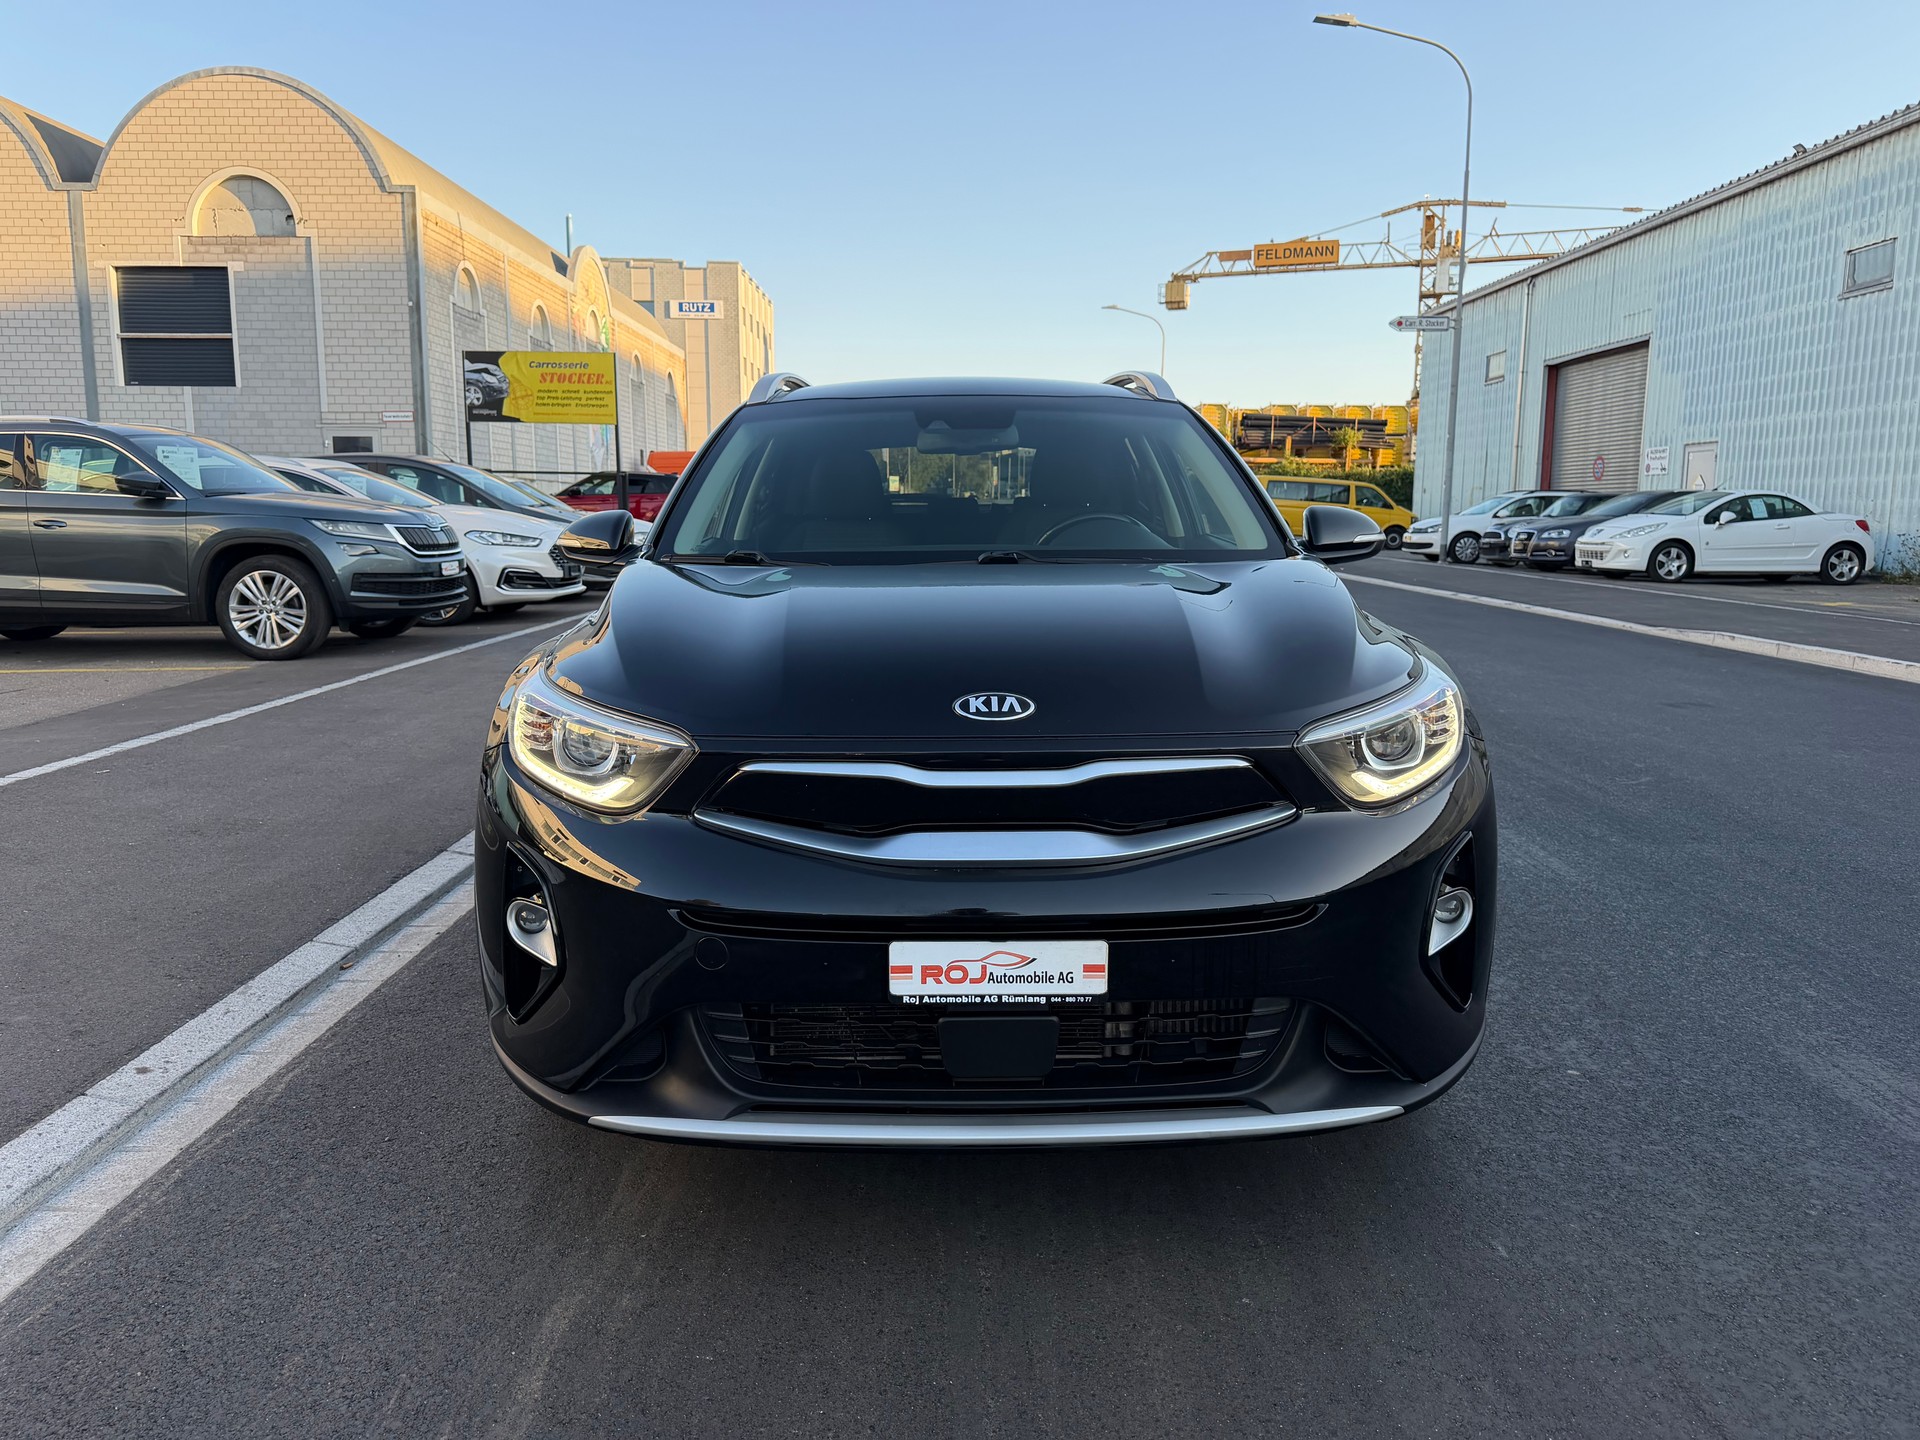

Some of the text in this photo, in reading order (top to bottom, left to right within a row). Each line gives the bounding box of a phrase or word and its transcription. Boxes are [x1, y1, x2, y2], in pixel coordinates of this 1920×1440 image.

[1257, 245, 1334, 260] FELDMANN
[682, 302, 711, 312] RUTZ
[529, 361, 589, 370] Carrosserie
[539, 372, 605, 385] STOCKER
[968, 695, 1022, 713] KIA
[920, 964, 1075, 985] ROJ Automobile AG
[902, 995, 920, 1005] Roj
[922, 995, 981, 1003] Automobile
[983, 995, 999, 1003] AG
[1001, 994, 1047, 1004] Rümlang
